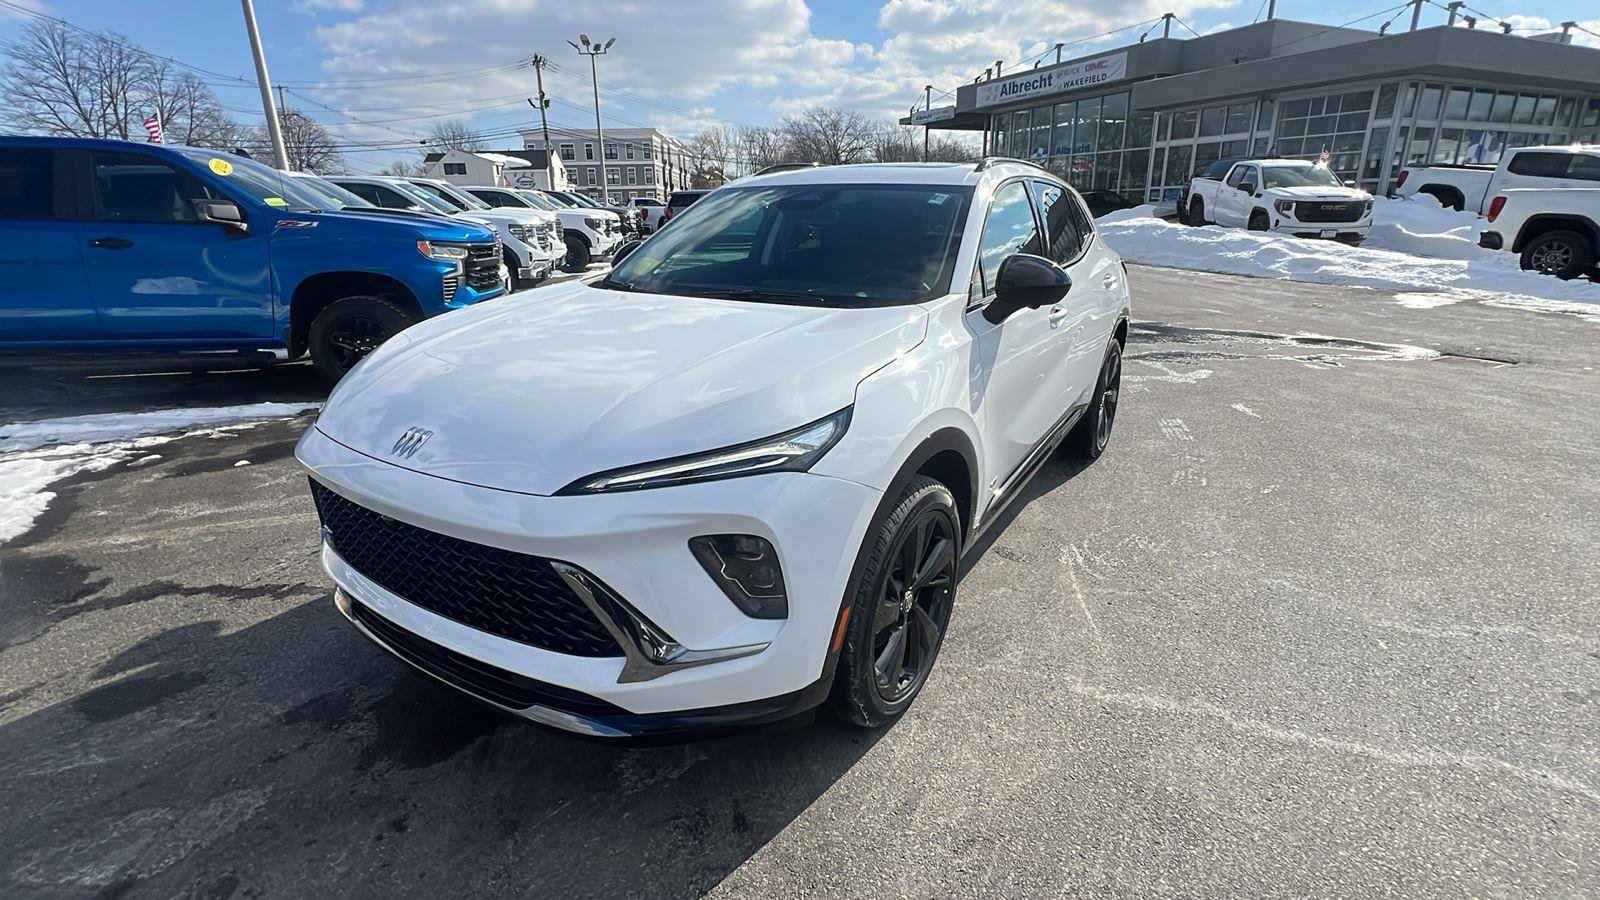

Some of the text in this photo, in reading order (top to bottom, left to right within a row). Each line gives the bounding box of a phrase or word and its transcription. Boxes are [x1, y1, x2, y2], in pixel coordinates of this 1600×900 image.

[1084, 60, 1108, 72] GMC
[1000, 73, 1053, 97] Albrecht
[1063, 73, 1107, 88] WAKEFIELD
